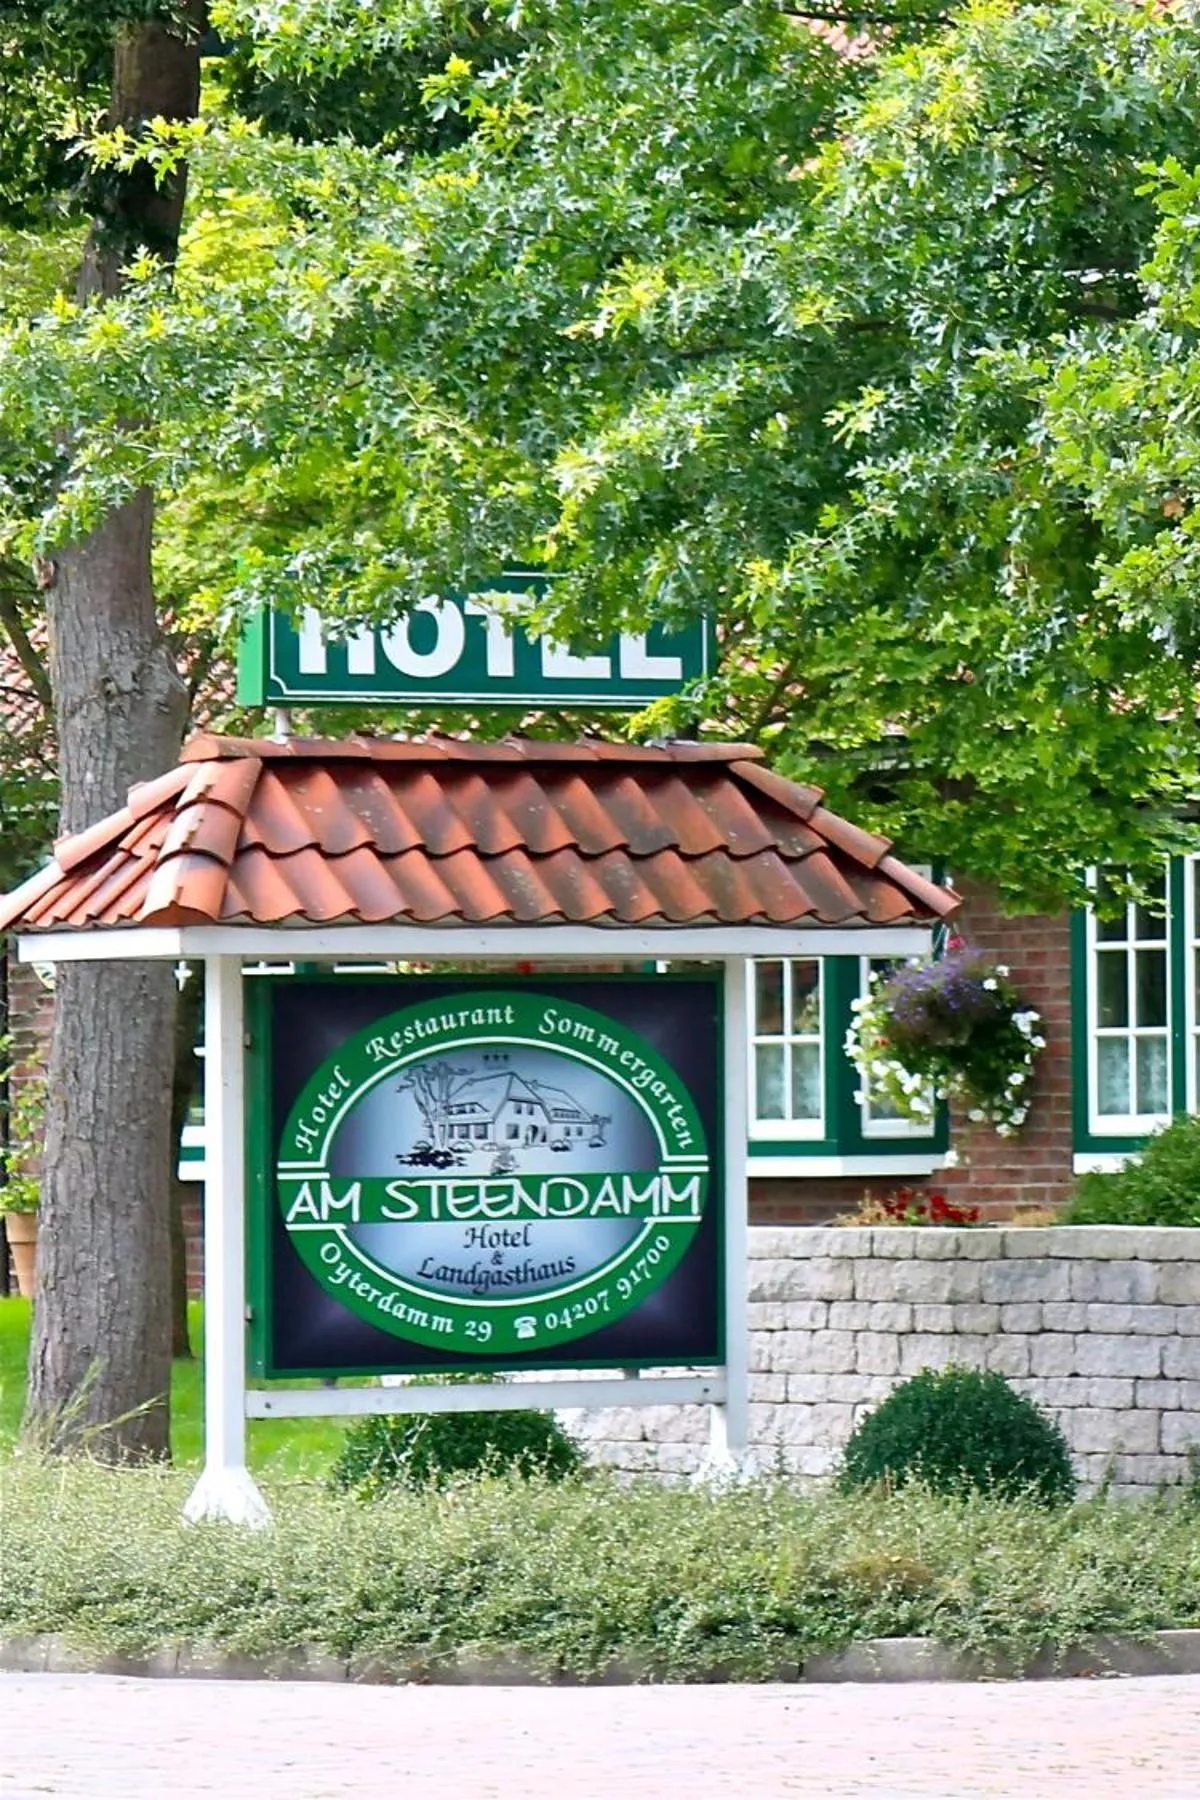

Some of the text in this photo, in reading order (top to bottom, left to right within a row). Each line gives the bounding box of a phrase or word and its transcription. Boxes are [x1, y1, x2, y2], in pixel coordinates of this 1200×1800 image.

[295, 1004, 693, 1154] Hotel Restaurant Sommergarten
[287, 1175, 700, 1222] AM STEENDAMM
[463, 1223, 532, 1250] Hotel
[491, 1251, 504, 1265] &
[319, 1241, 493, 1341] Oyterdamm 29
[416, 1256, 576, 1295] Landgasthaus
[545, 1235, 671, 1331] 04207 91700
